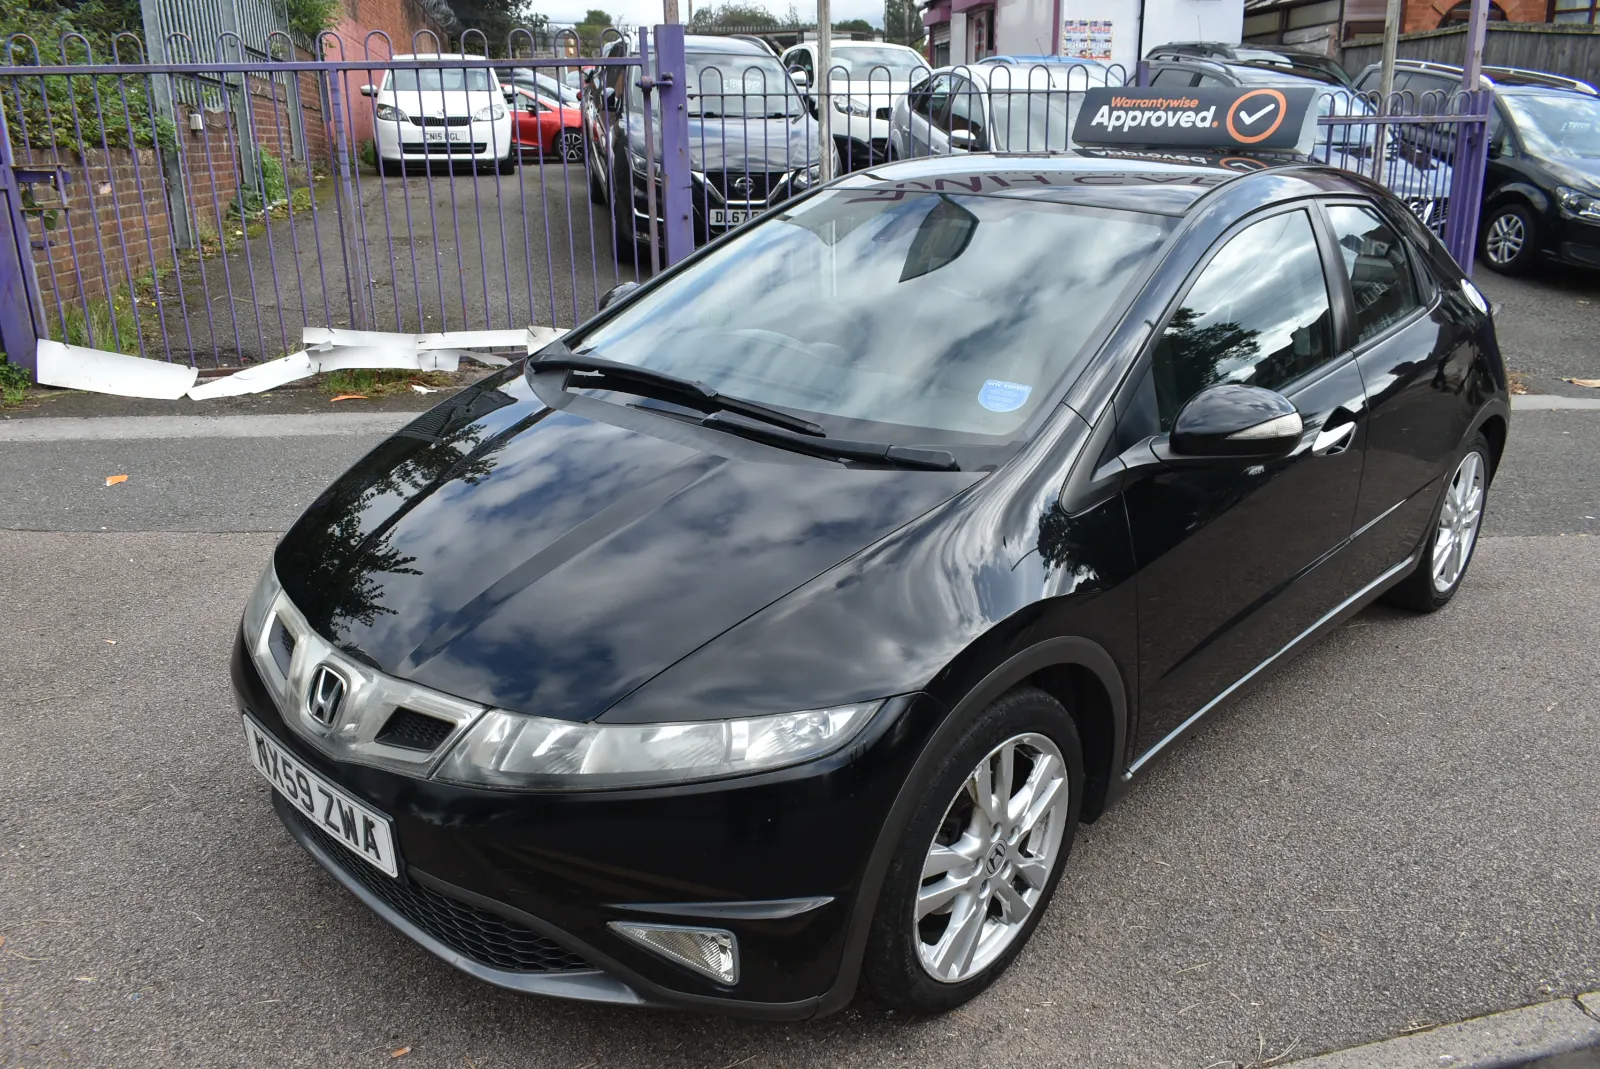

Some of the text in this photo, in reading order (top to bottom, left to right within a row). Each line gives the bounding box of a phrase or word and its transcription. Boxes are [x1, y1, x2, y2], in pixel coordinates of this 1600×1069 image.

[1111, 97, 1199, 109] Warrantywise
[1091, 105, 1219, 131] Approved.
[254, 730, 382, 861] NX59 ZWA
